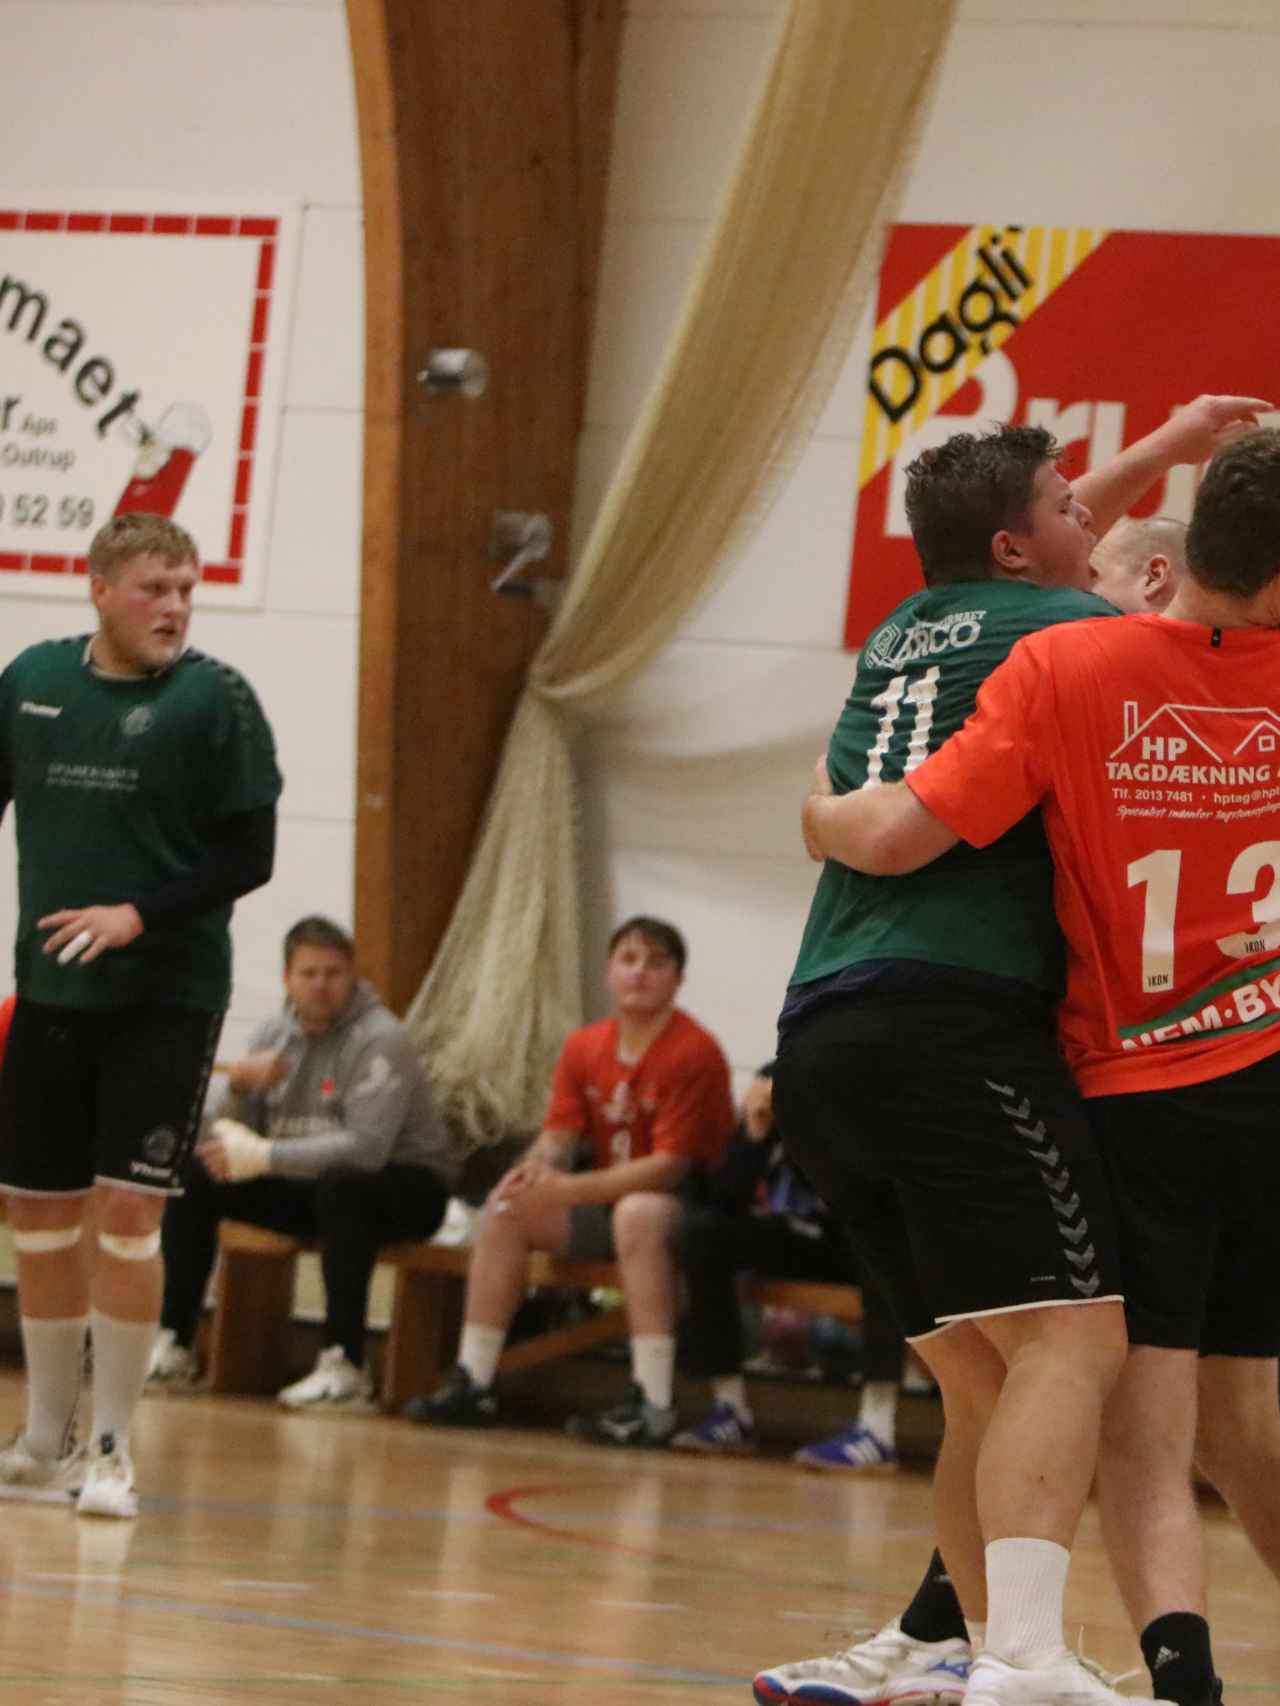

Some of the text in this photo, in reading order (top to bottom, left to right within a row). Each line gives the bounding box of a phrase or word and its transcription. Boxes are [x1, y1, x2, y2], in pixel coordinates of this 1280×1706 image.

[15, 494, 95, 529] 52 59
[862, 665, 941, 789] 11
[1142, 736, 1188, 761] HP
[1105, 762, 1270, 784] TAGDÆKNING
[1112, 788, 1132, 799] Tlf.
[1135, 789, 1164, 800] 2013
[1166, 790, 1193, 802] 7481
[1148, 974, 1168, 987] IKON
